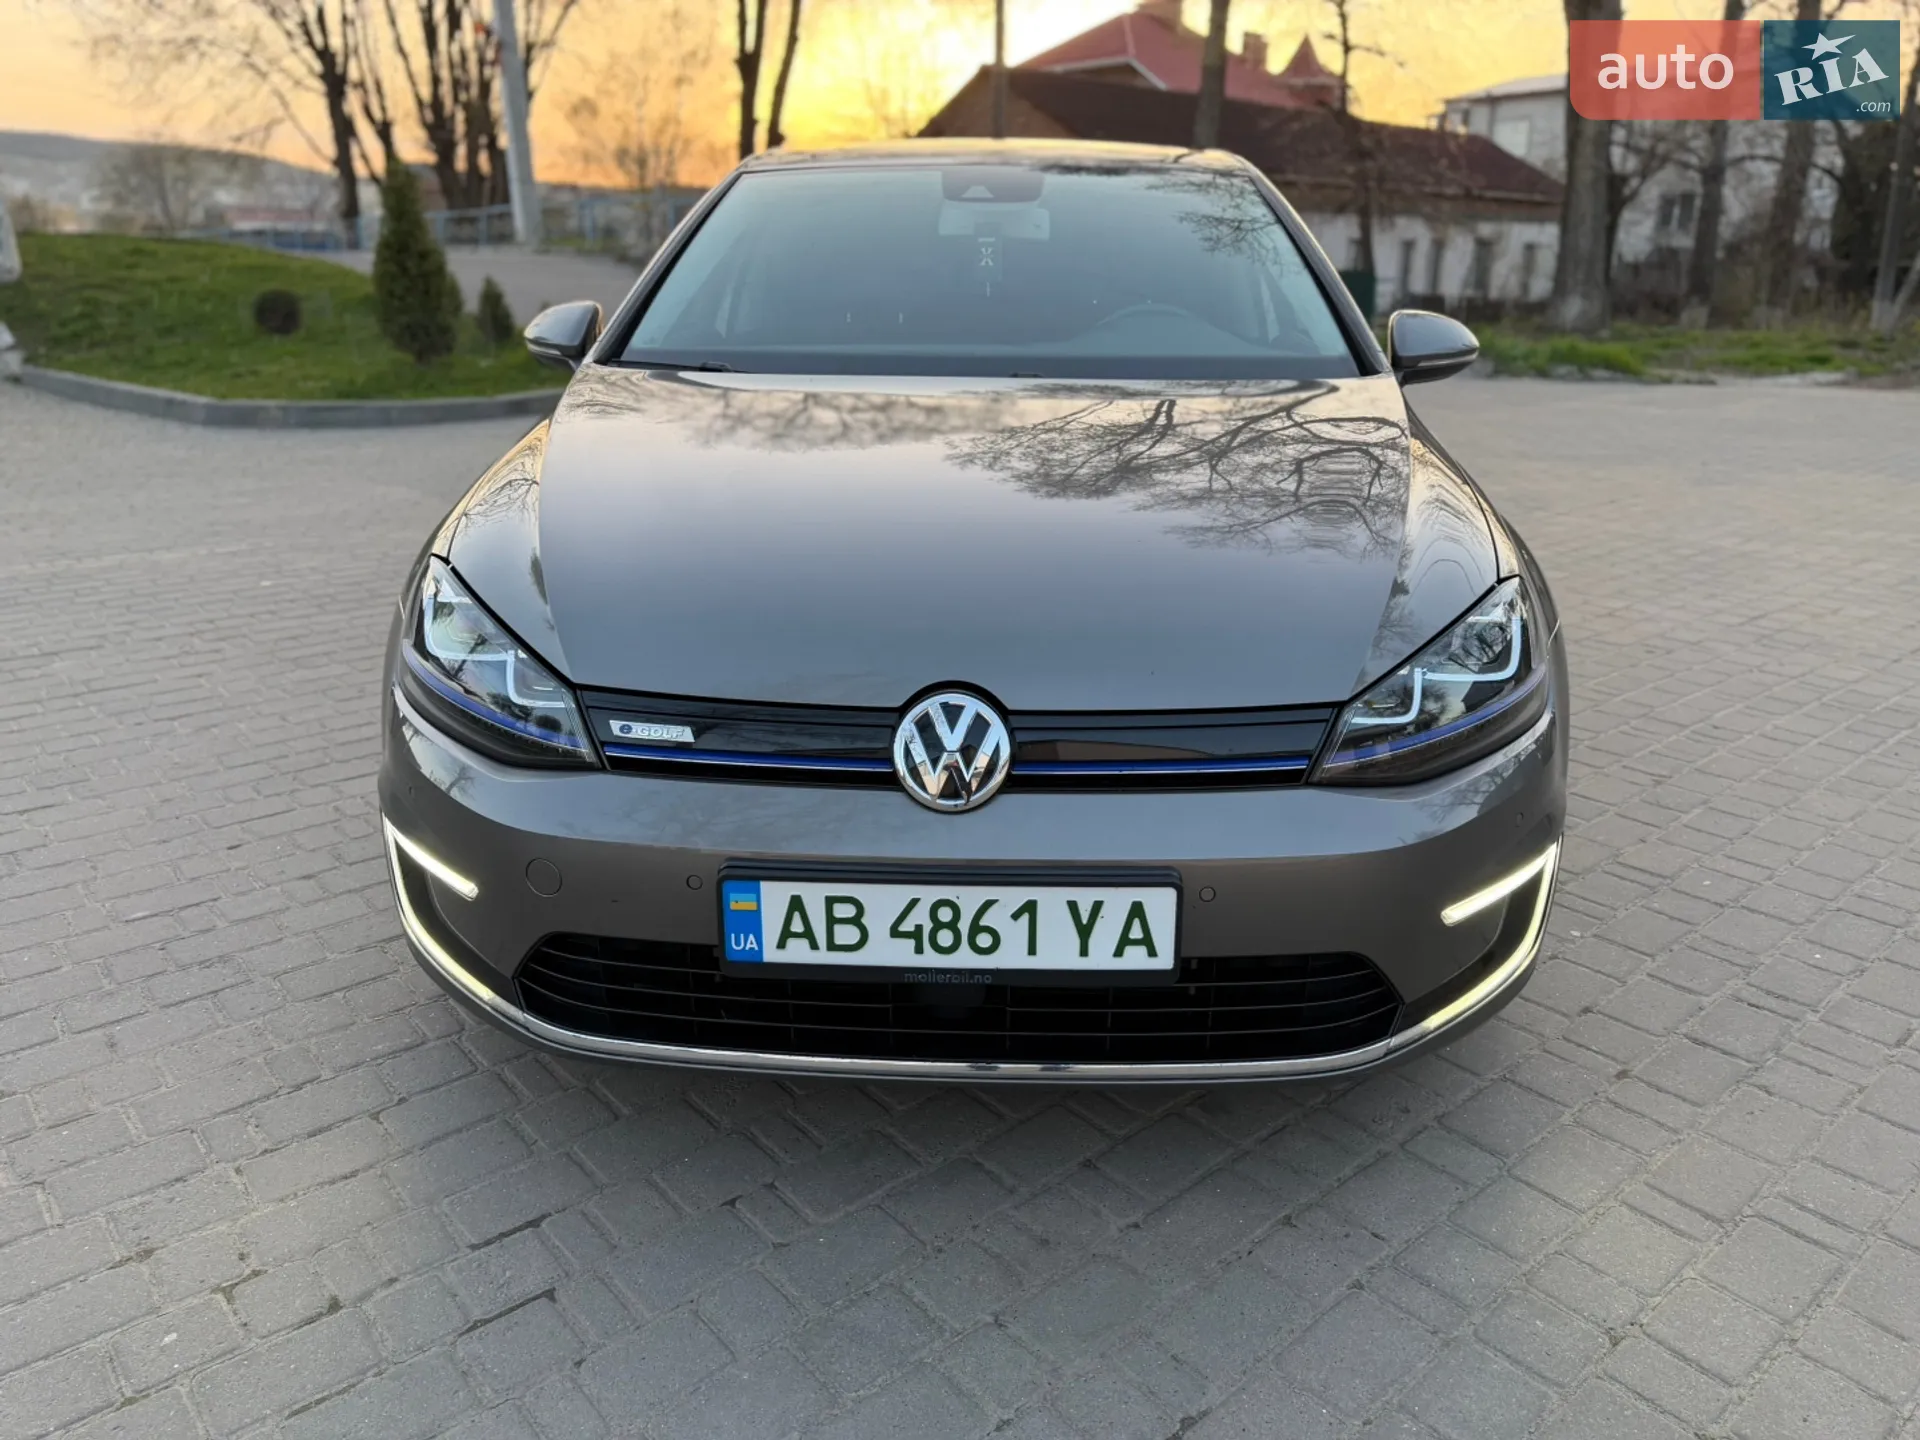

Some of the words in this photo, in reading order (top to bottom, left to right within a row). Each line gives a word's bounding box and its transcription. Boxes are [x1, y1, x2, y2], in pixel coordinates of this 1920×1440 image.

[731, 933, 758, 950] UA
[776, 894, 869, 952] AB
[889, 897, 1038, 956] 4861
[1066, 899, 1158, 958] YA
